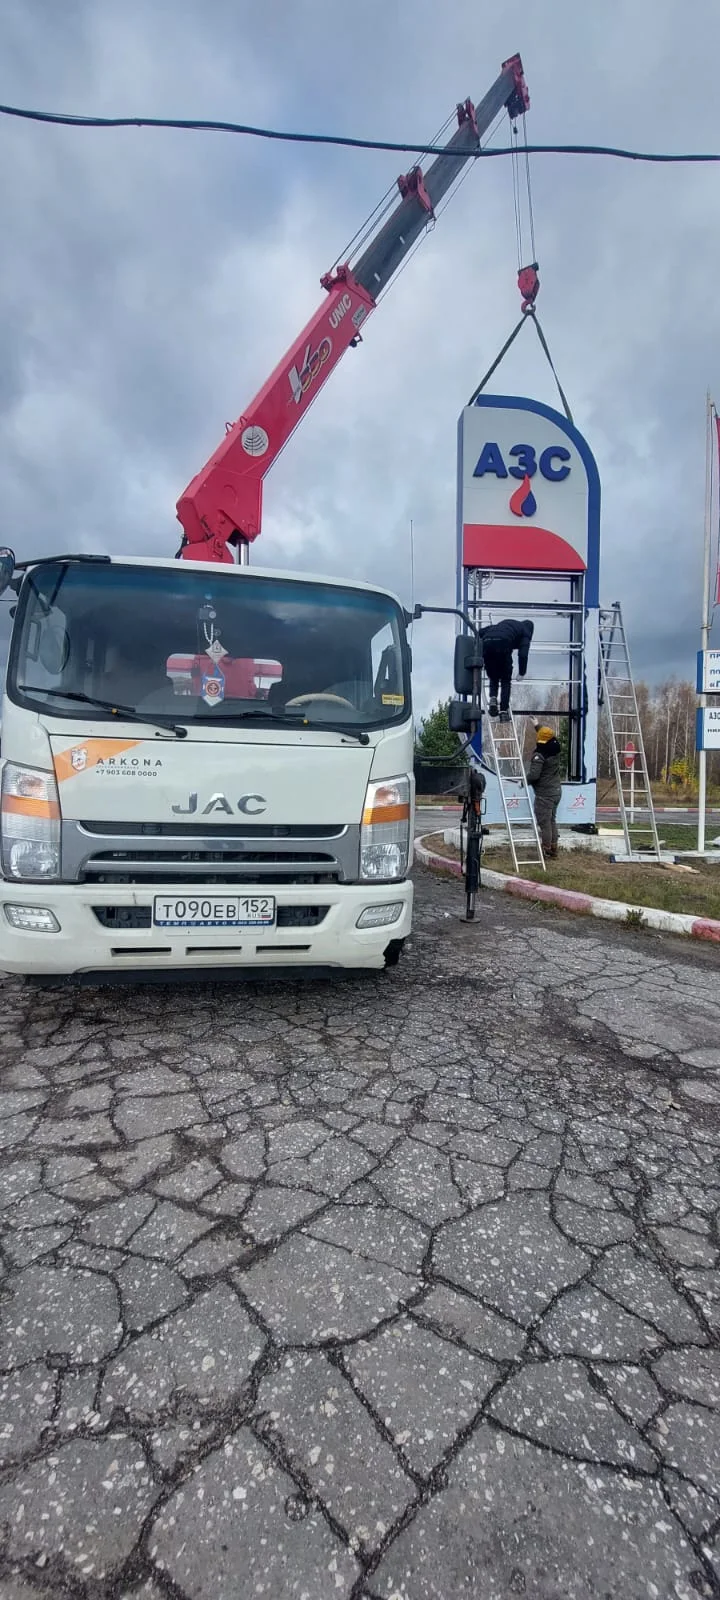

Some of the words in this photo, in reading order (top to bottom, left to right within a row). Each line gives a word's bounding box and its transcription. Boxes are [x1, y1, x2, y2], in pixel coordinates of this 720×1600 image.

[328, 293, 352, 329] UNIC
[472, 442, 572, 482] АЗС
[96, 758, 163, 767] ARKONA
[171, 791, 267, 816] JAC
[163, 900, 236, 918] Т090ЕВ
[241, 899, 269, 913] 152
